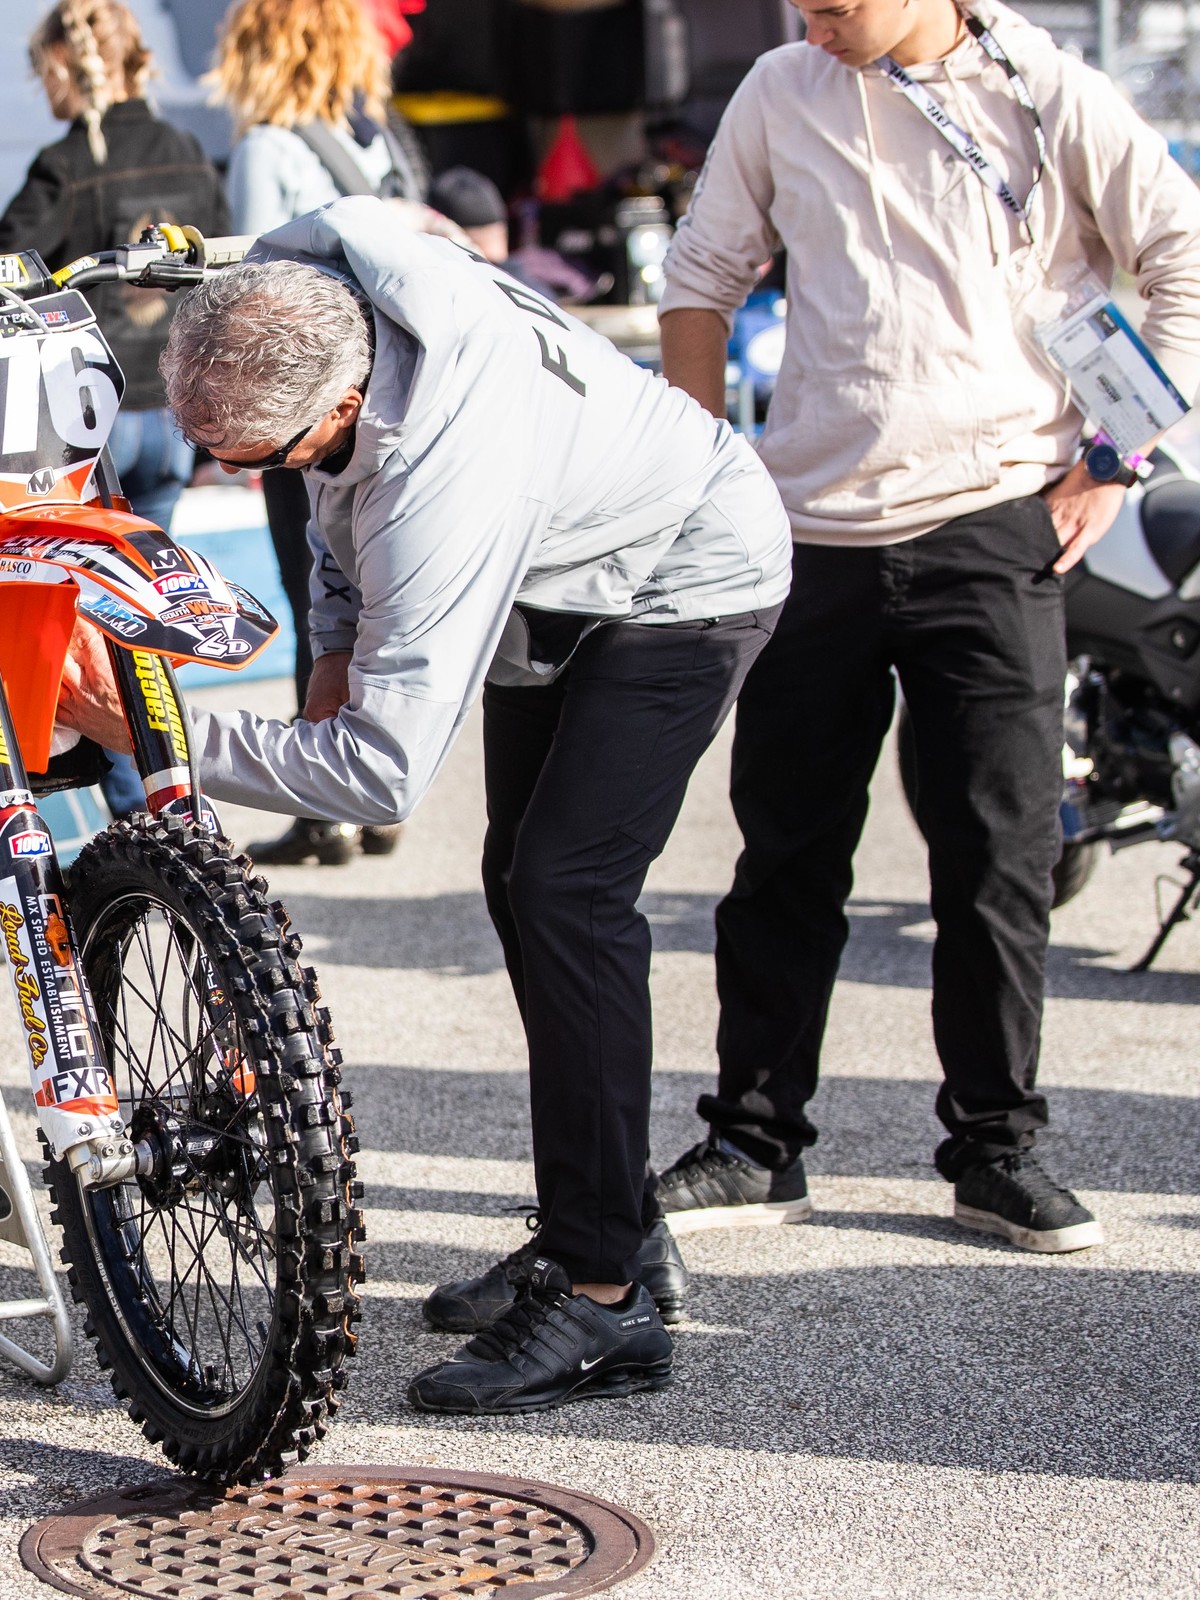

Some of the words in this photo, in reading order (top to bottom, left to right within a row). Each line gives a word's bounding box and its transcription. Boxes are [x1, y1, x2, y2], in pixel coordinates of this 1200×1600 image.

[158, 575, 205, 594] 100%
[132, 650, 170, 732] Facto
[15, 835, 49, 853] 100%
[14, 963, 47, 1033] Fuel
[25, 896, 36, 914] MX
[31, 919, 48, 956] SPEED
[40, 960, 71, 1060] ESTABLISHMENT
[38, 893, 95, 1058] CNING
[52, 1067, 112, 1103] FXR
[105, 1283, 123, 1319] EXCEL
